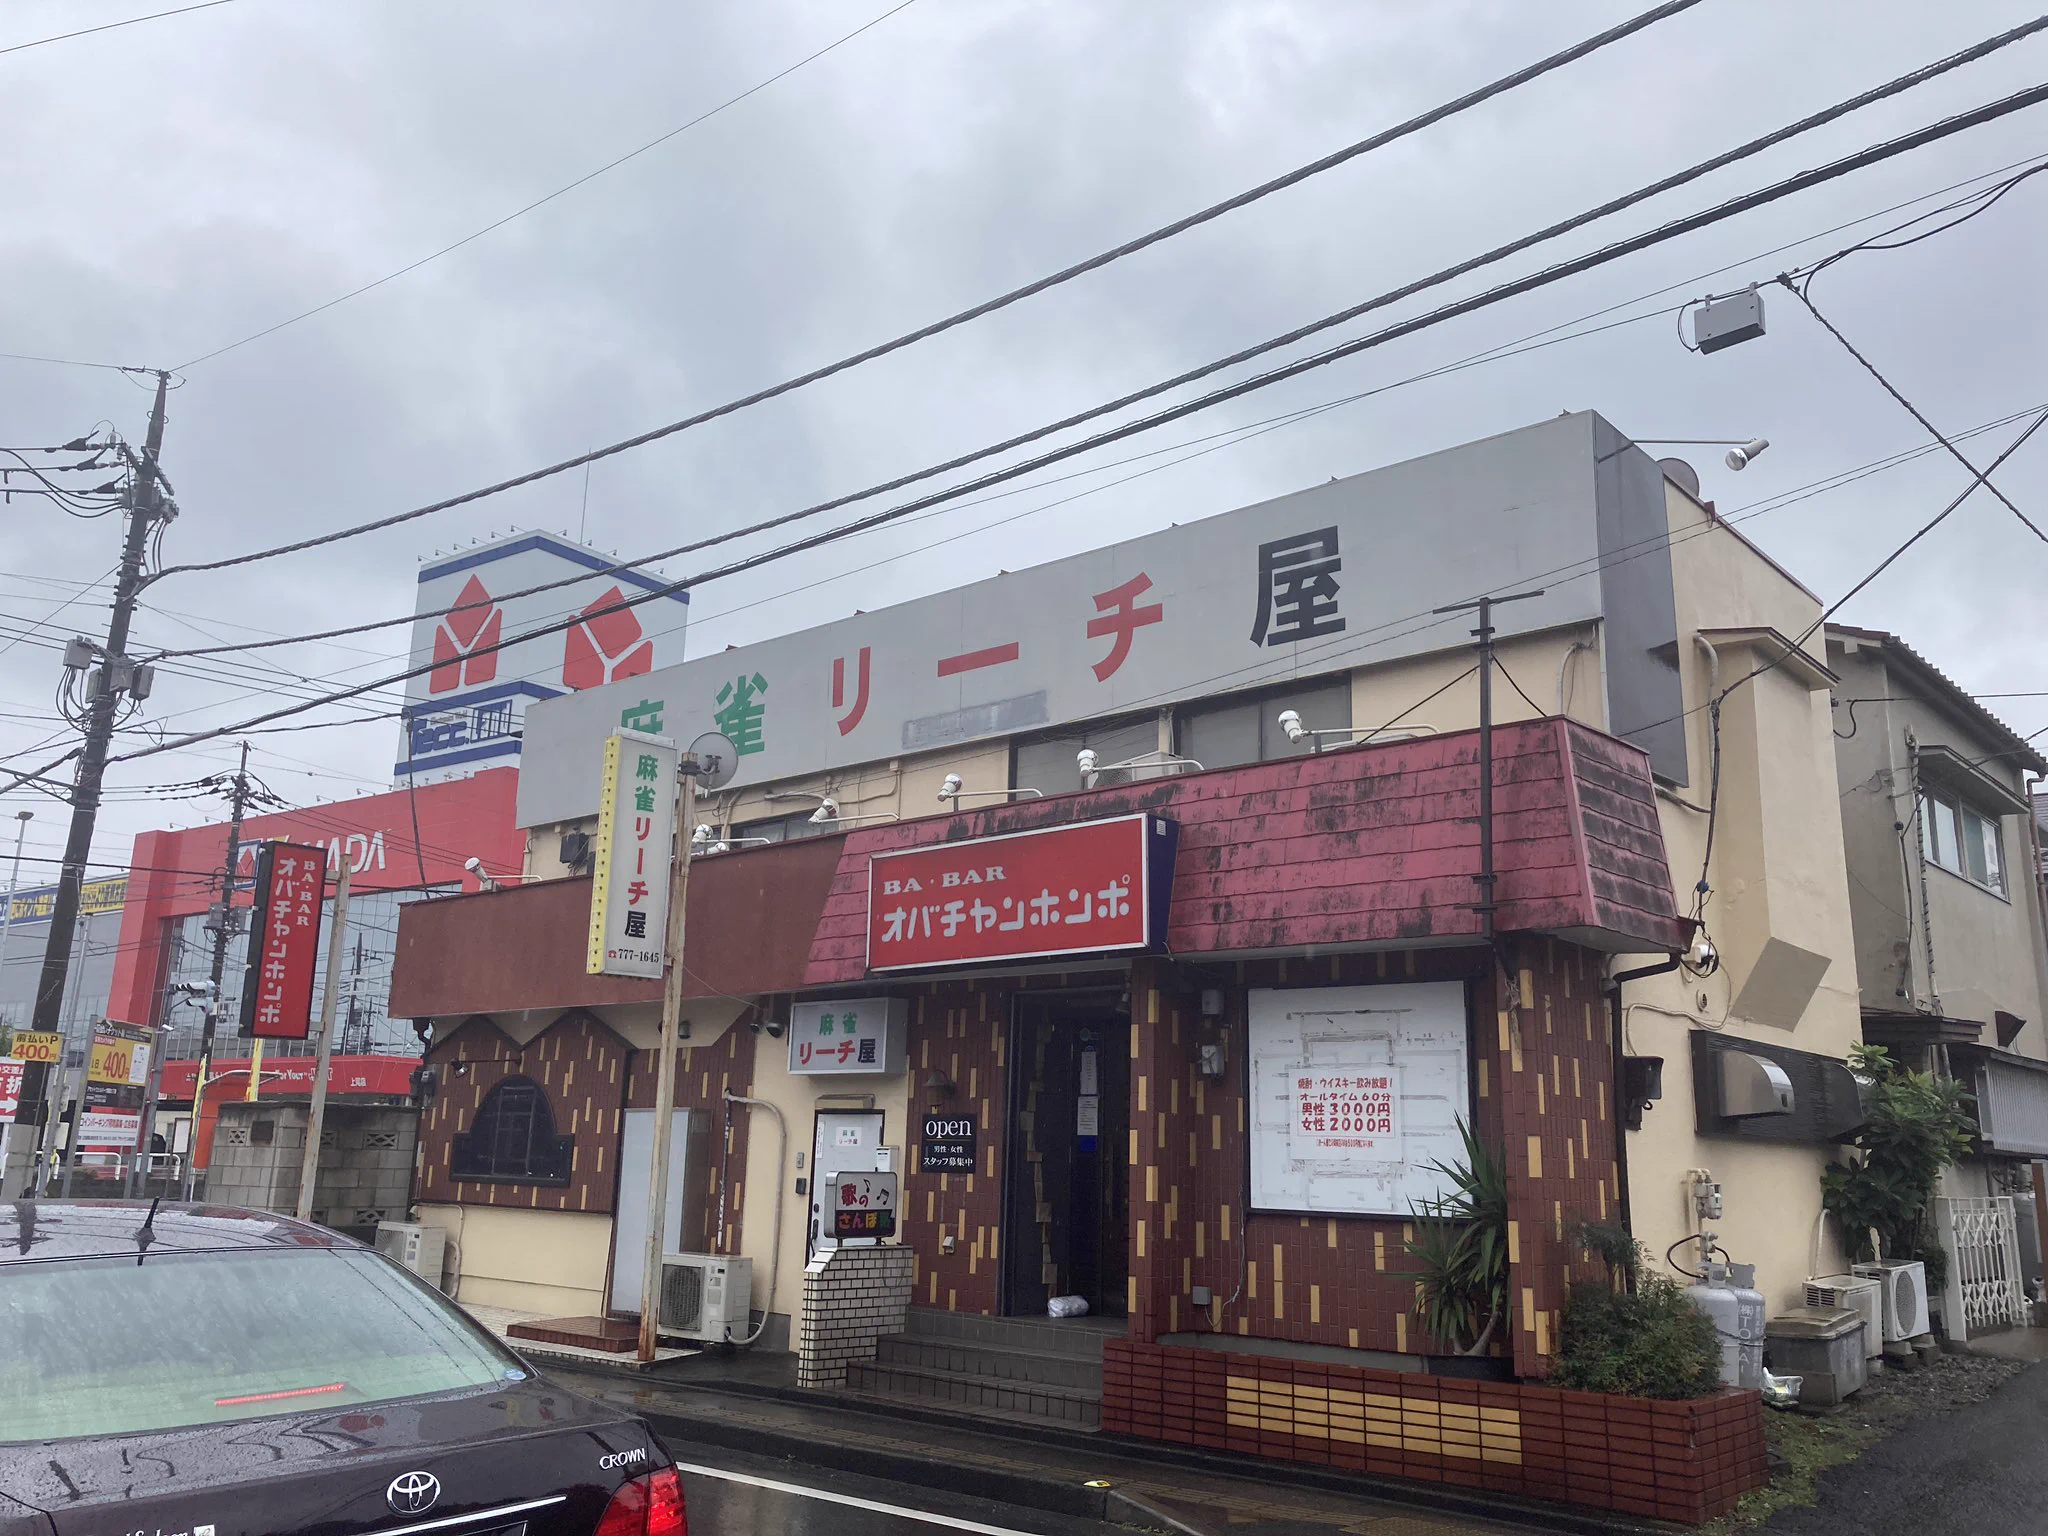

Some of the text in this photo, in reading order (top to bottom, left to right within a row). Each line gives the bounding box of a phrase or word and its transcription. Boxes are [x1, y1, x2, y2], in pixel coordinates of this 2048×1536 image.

[624, 754, 659, 939] 麻雀リーチ屋
[881, 874, 1130, 942] オバチャンホンポ
[618, 948, 660, 963] 777-1645
[819, 1012, 858, 1036] 麻雀
[12, 1044, 57, 1060] 400円
[800, 1038, 876, 1065] リーチ屋
[1300, 1092, 1392, 1102] オールタイム 60分
[1302, 1102, 1391, 1116] 男性 3000円
[926, 1120, 972, 1139] open
[1301, 1117, 1391, 1133] 女性 2000円
[933, 1145, 963, 1153] 男性・女性
[923, 1157, 973, 1167] スタッフ募集中
[841, 1183, 869, 1208] 歌の
[599, 1447, 646, 1470] CROWN
